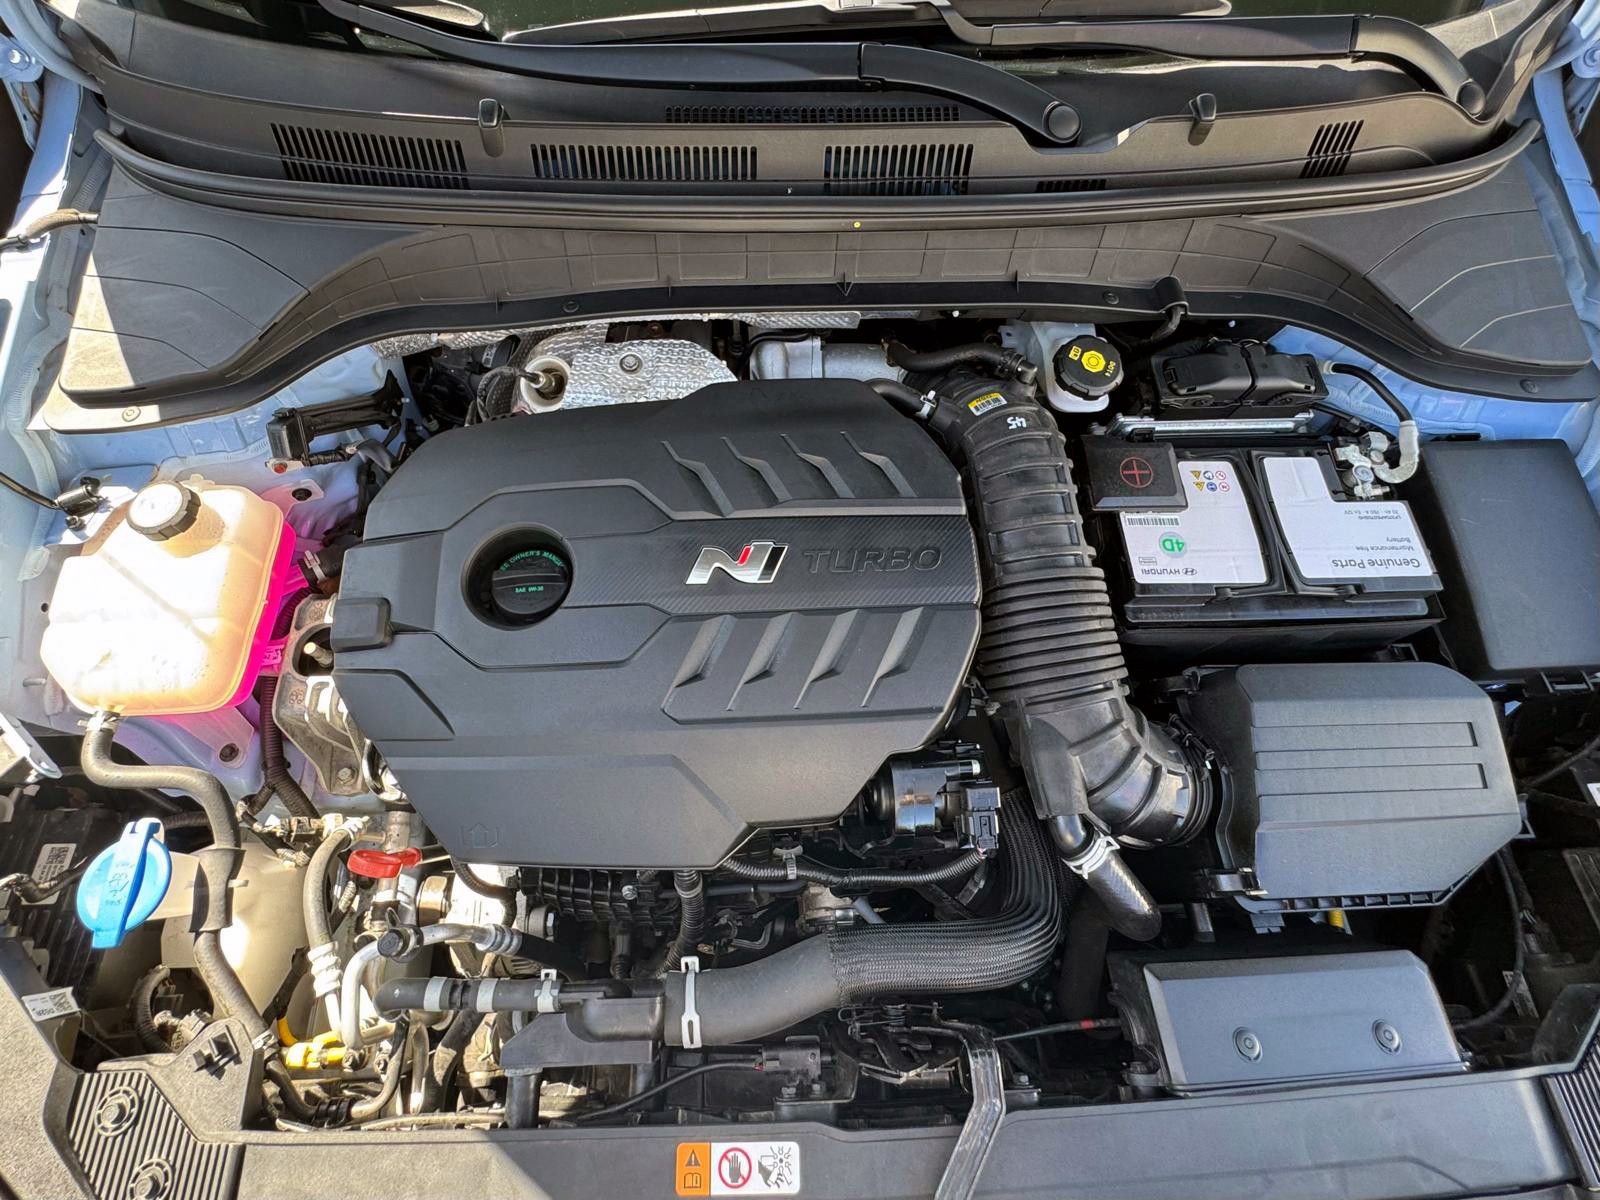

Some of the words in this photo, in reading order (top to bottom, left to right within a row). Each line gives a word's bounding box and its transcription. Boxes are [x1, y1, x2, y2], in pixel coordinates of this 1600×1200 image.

[1162, 538, 1185, 552] 4D
[803, 548, 943, 574] TURBO
[1331, 559, 1366, 569] Parts
[1367, 558, 1420, 568] Genuine
